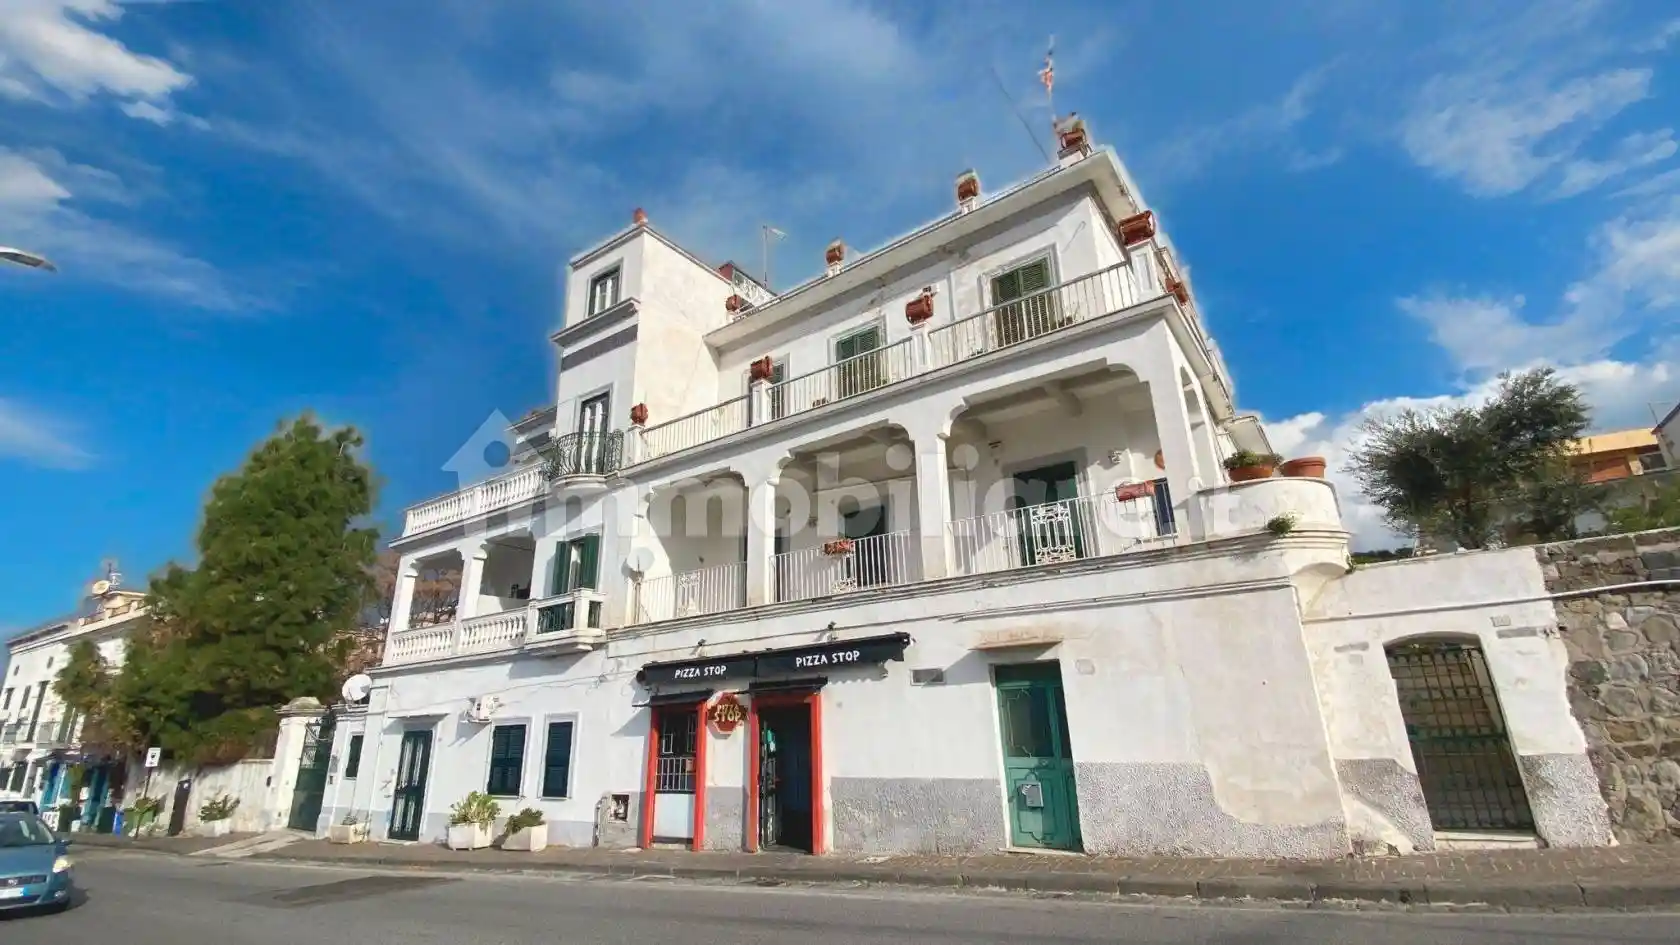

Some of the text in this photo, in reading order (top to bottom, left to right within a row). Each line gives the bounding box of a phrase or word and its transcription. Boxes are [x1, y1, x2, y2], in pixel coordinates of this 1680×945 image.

[795, 650, 861, 668] PIZZA STOP
[674, 665, 727, 679] PIZZA STOP
[714, 704, 742, 722] PIZZA STOP
